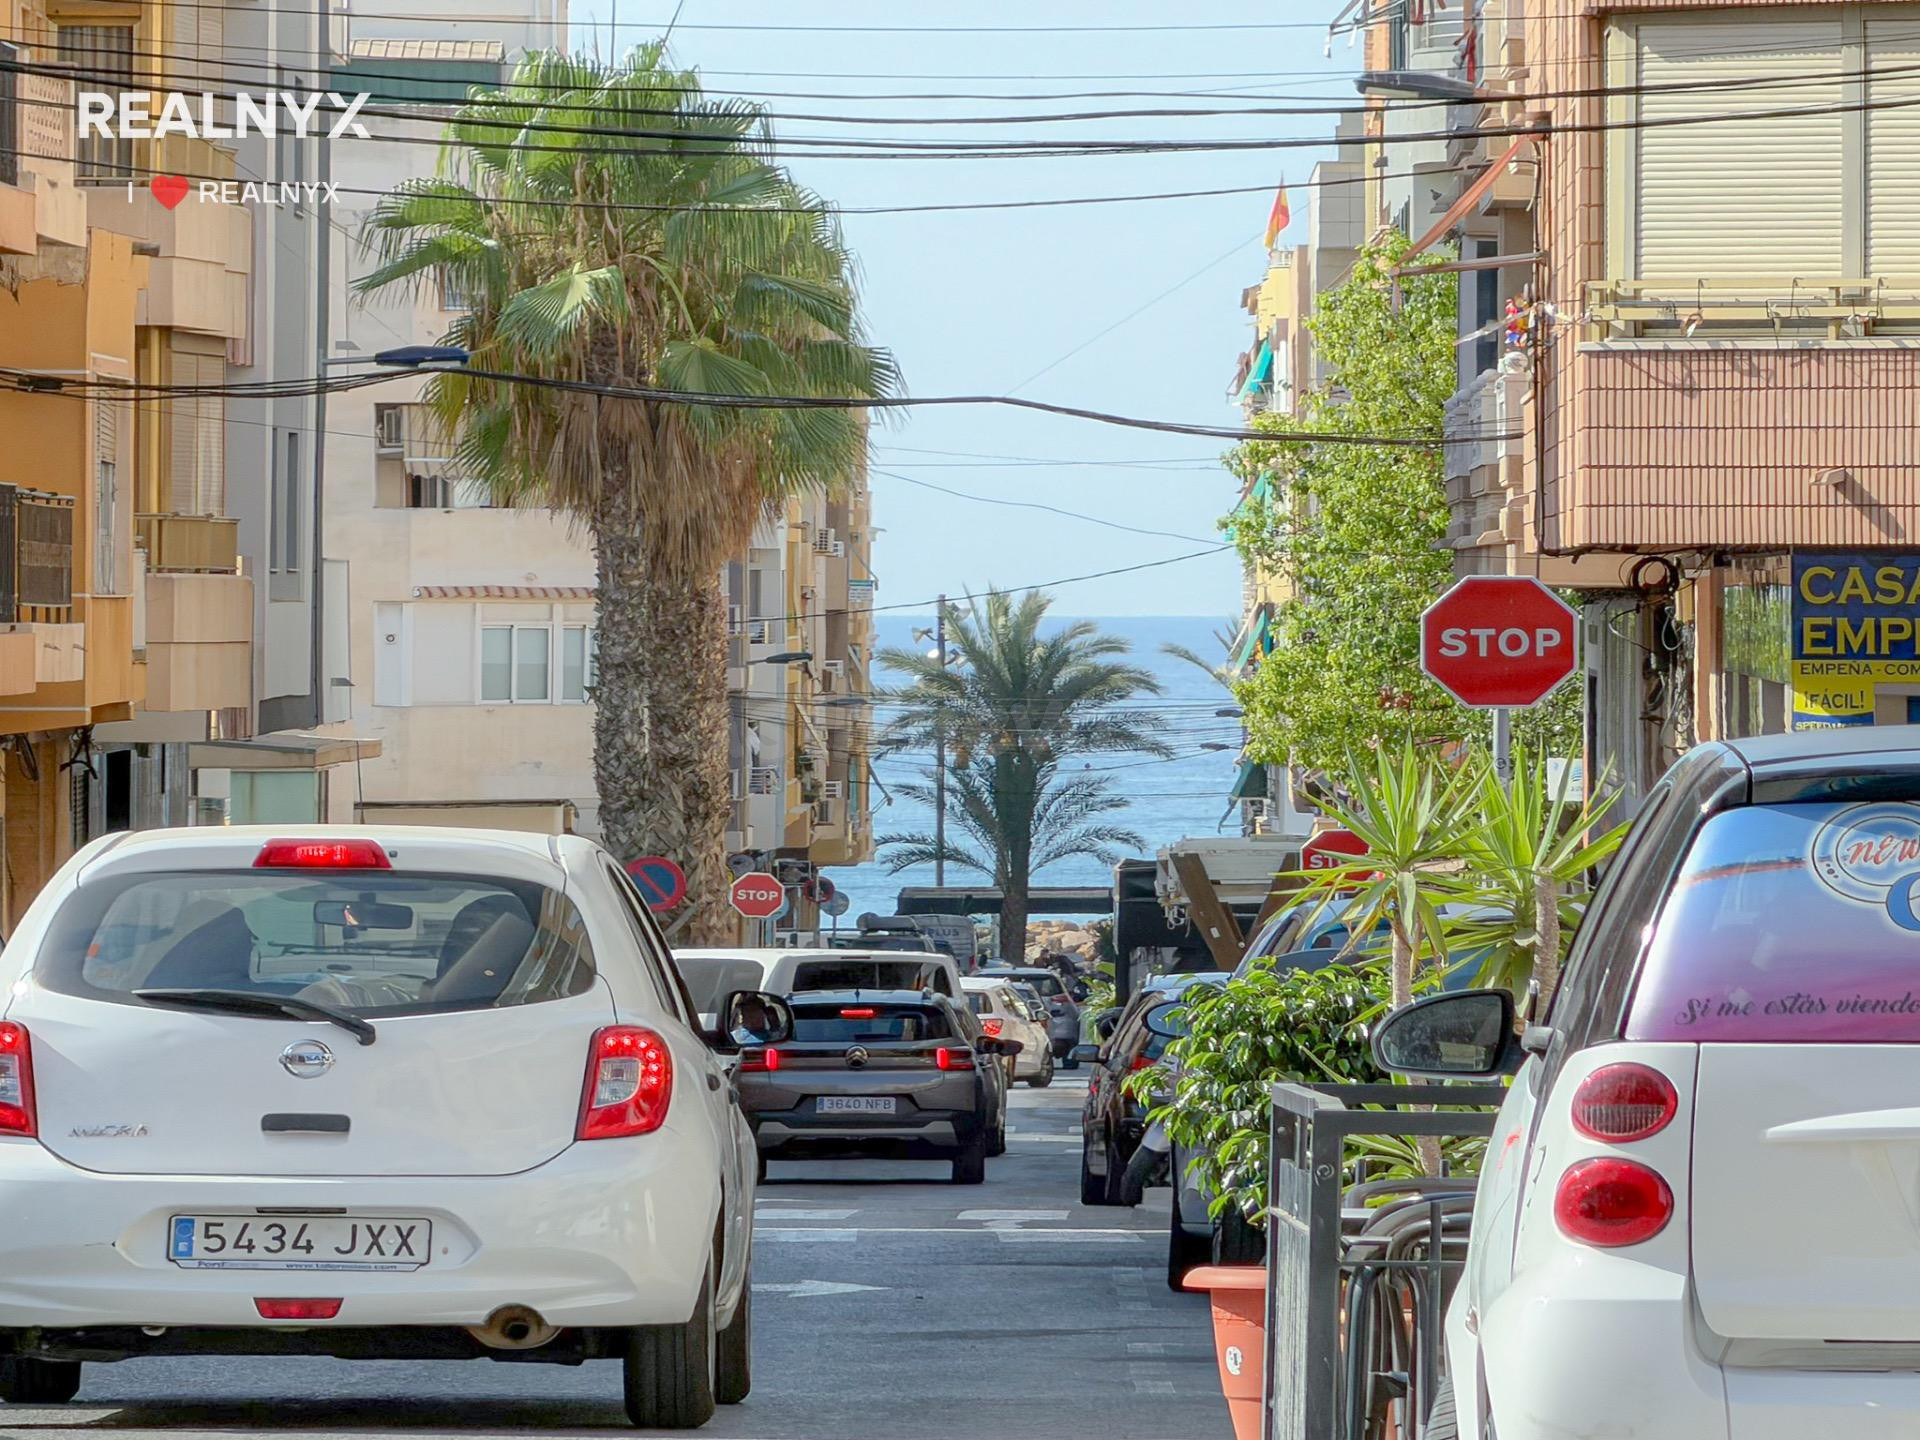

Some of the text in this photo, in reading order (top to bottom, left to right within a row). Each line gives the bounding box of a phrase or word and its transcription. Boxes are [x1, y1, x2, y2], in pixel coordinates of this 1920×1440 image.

[1439, 628, 1561, 657] STOP
[1801, 617, 1920, 656] EMP
[1800, 661, 1873, 676] EMPEÑA
[736, 889, 779, 901] STOP
[826, 1098, 892, 1110] 3640 NFB
[203, 1221, 417, 1258] 5434 JXX
